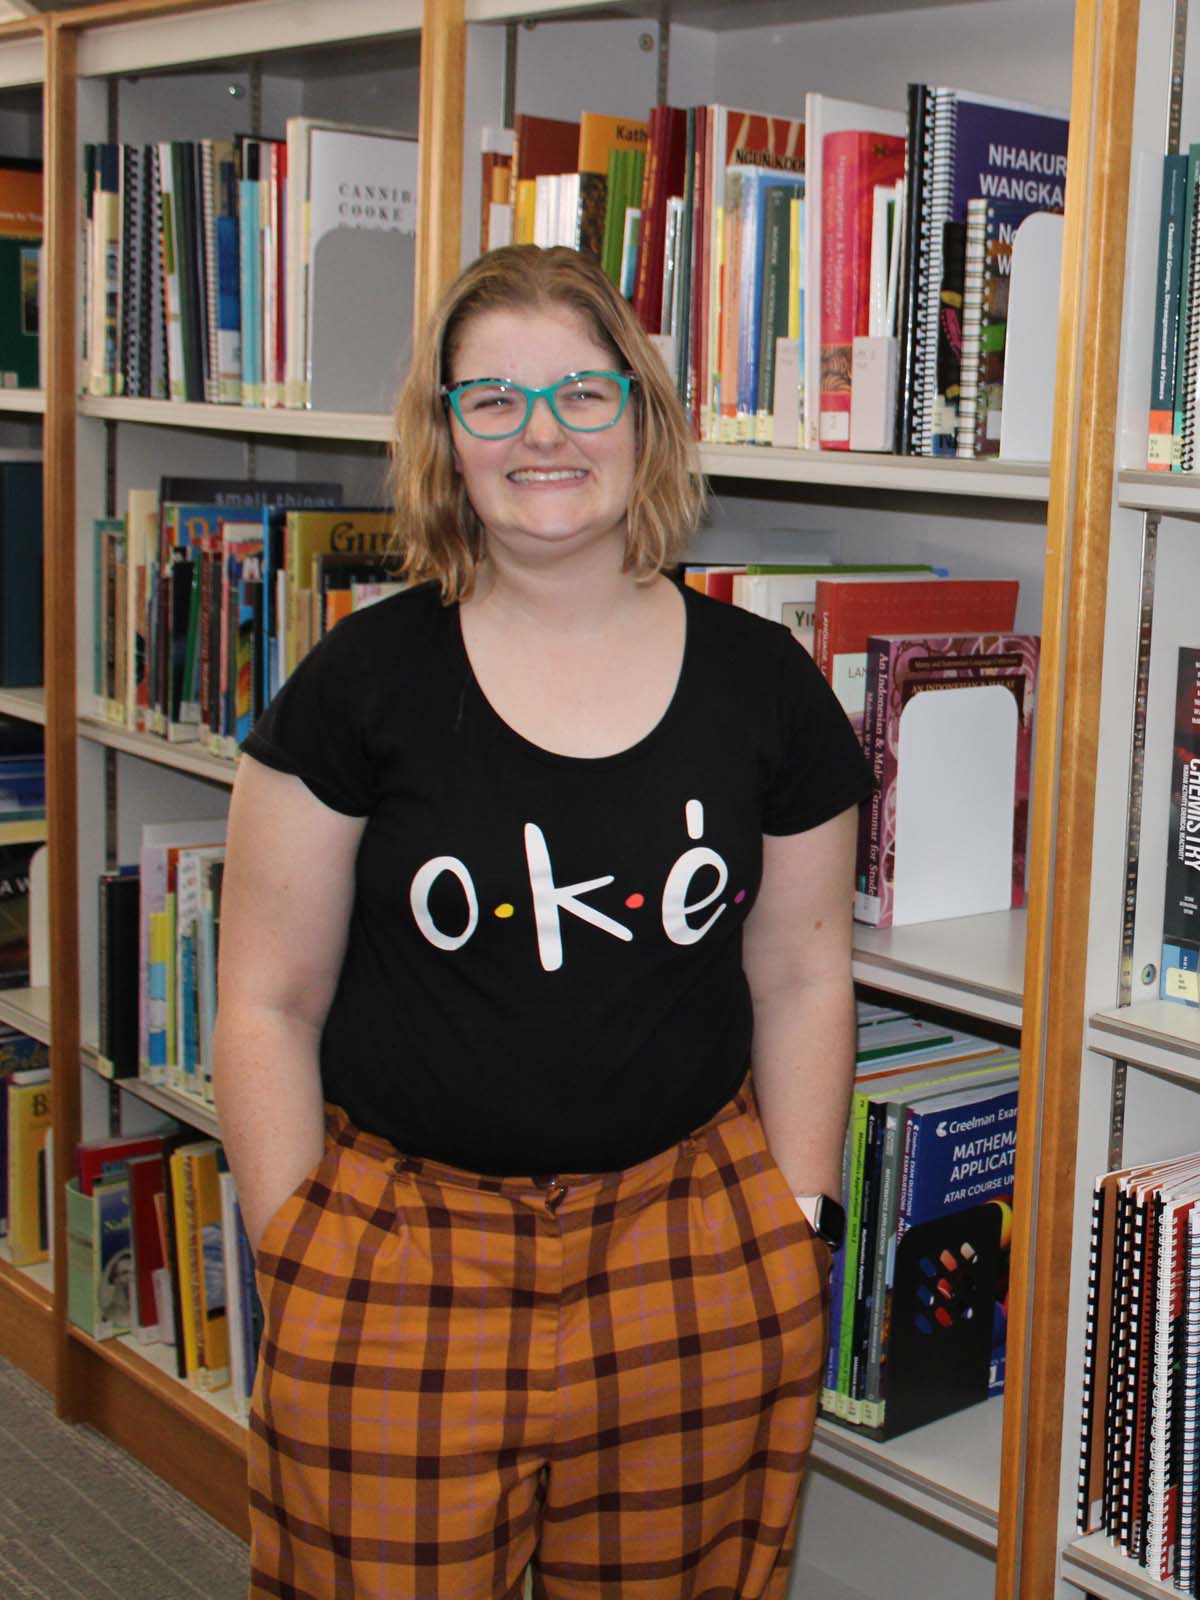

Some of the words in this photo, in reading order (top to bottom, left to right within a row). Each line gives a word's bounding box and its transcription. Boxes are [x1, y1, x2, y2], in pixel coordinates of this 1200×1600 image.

[735, 148, 771, 167] NGUN
[979, 172, 1064, 207] WANGKA
[338, 203, 402, 221] COOKE
[878, 653, 889, 671] An
[875, 672, 888, 735] Indonesian
[875, 737, 885, 747] &
[870, 844, 881, 861] for
[948, 1113, 995, 1134] Creelman
[943, 1187, 966, 1205] ATAR
[967, 1179, 1003, 1198] COURSE
